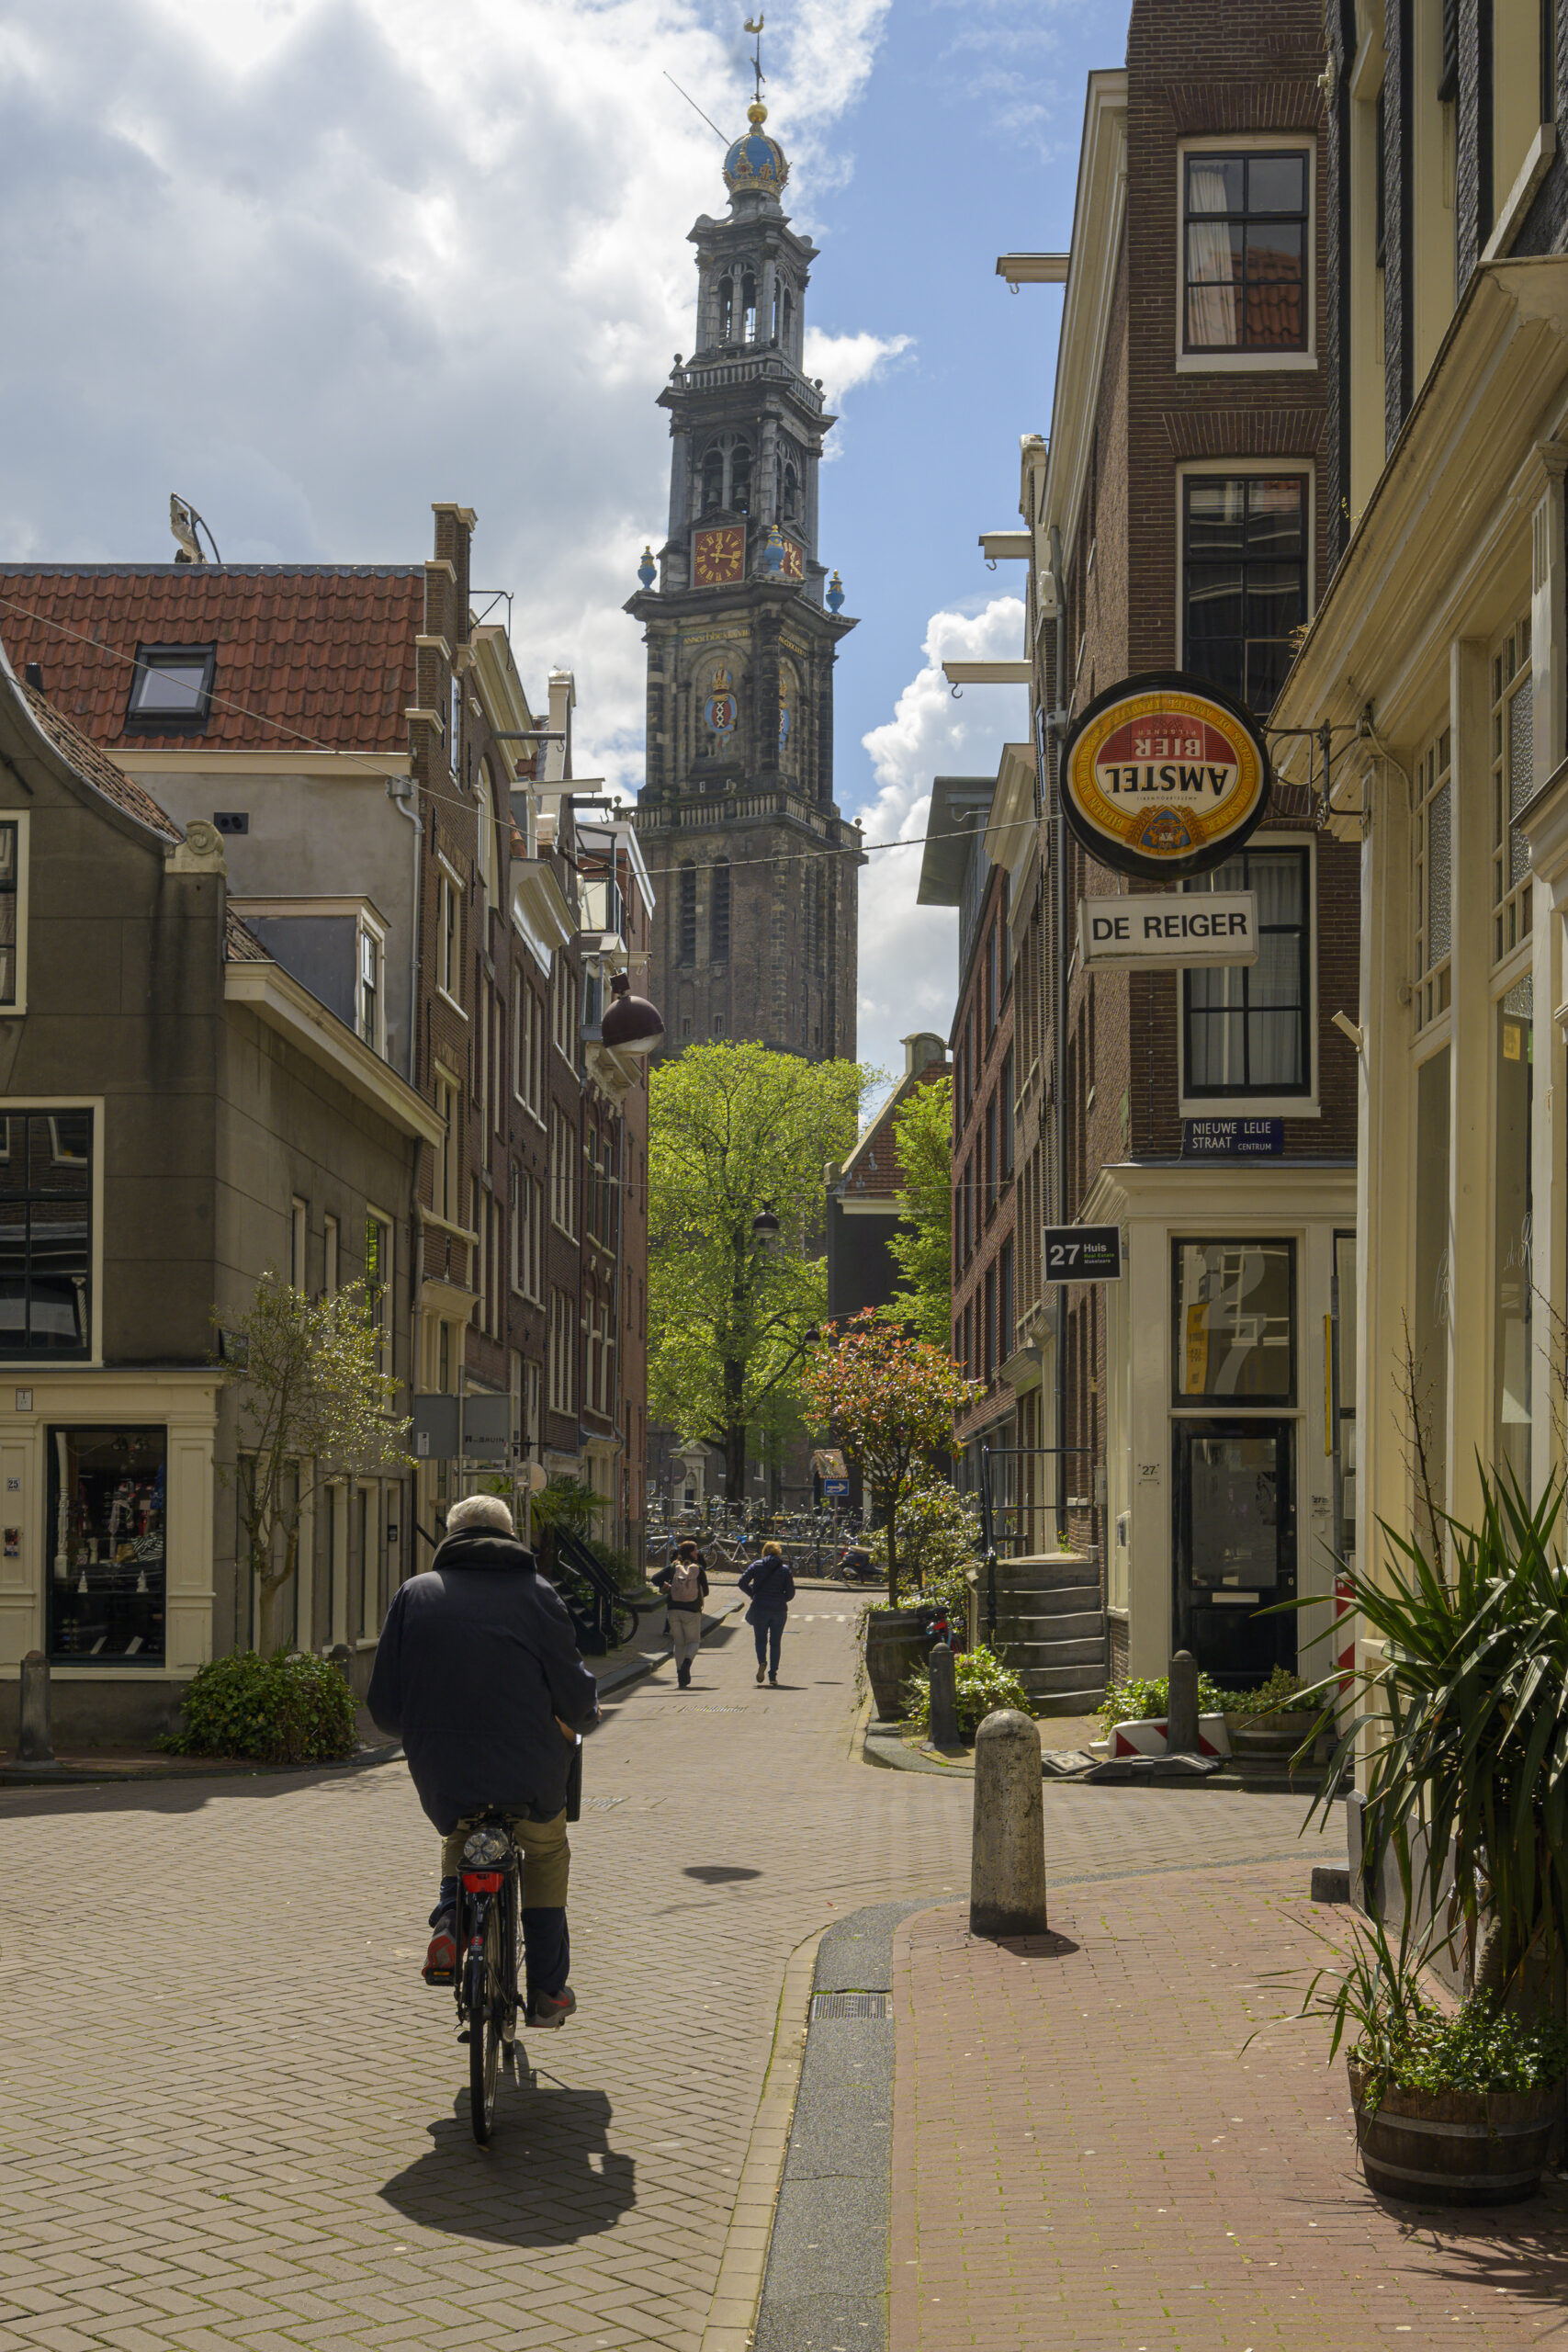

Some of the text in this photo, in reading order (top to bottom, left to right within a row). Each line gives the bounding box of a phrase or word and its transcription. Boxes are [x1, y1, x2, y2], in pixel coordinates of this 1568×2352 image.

[1134, 738, 1201, 758] BIER
[1105, 765, 1229, 797] AMSTEL
[1092, 912, 1248, 941] DE REIGER
[1192, 1122, 1271, 1135] NIEUWE LELIE
[1191, 1136, 1272, 1151] STRAAT CENTRUM
[1049, 1242, 1107, 1266] 27 Huis
[1142, 1465, 1156, 1476] 27
[8, 1480, 18, 1488] 25
